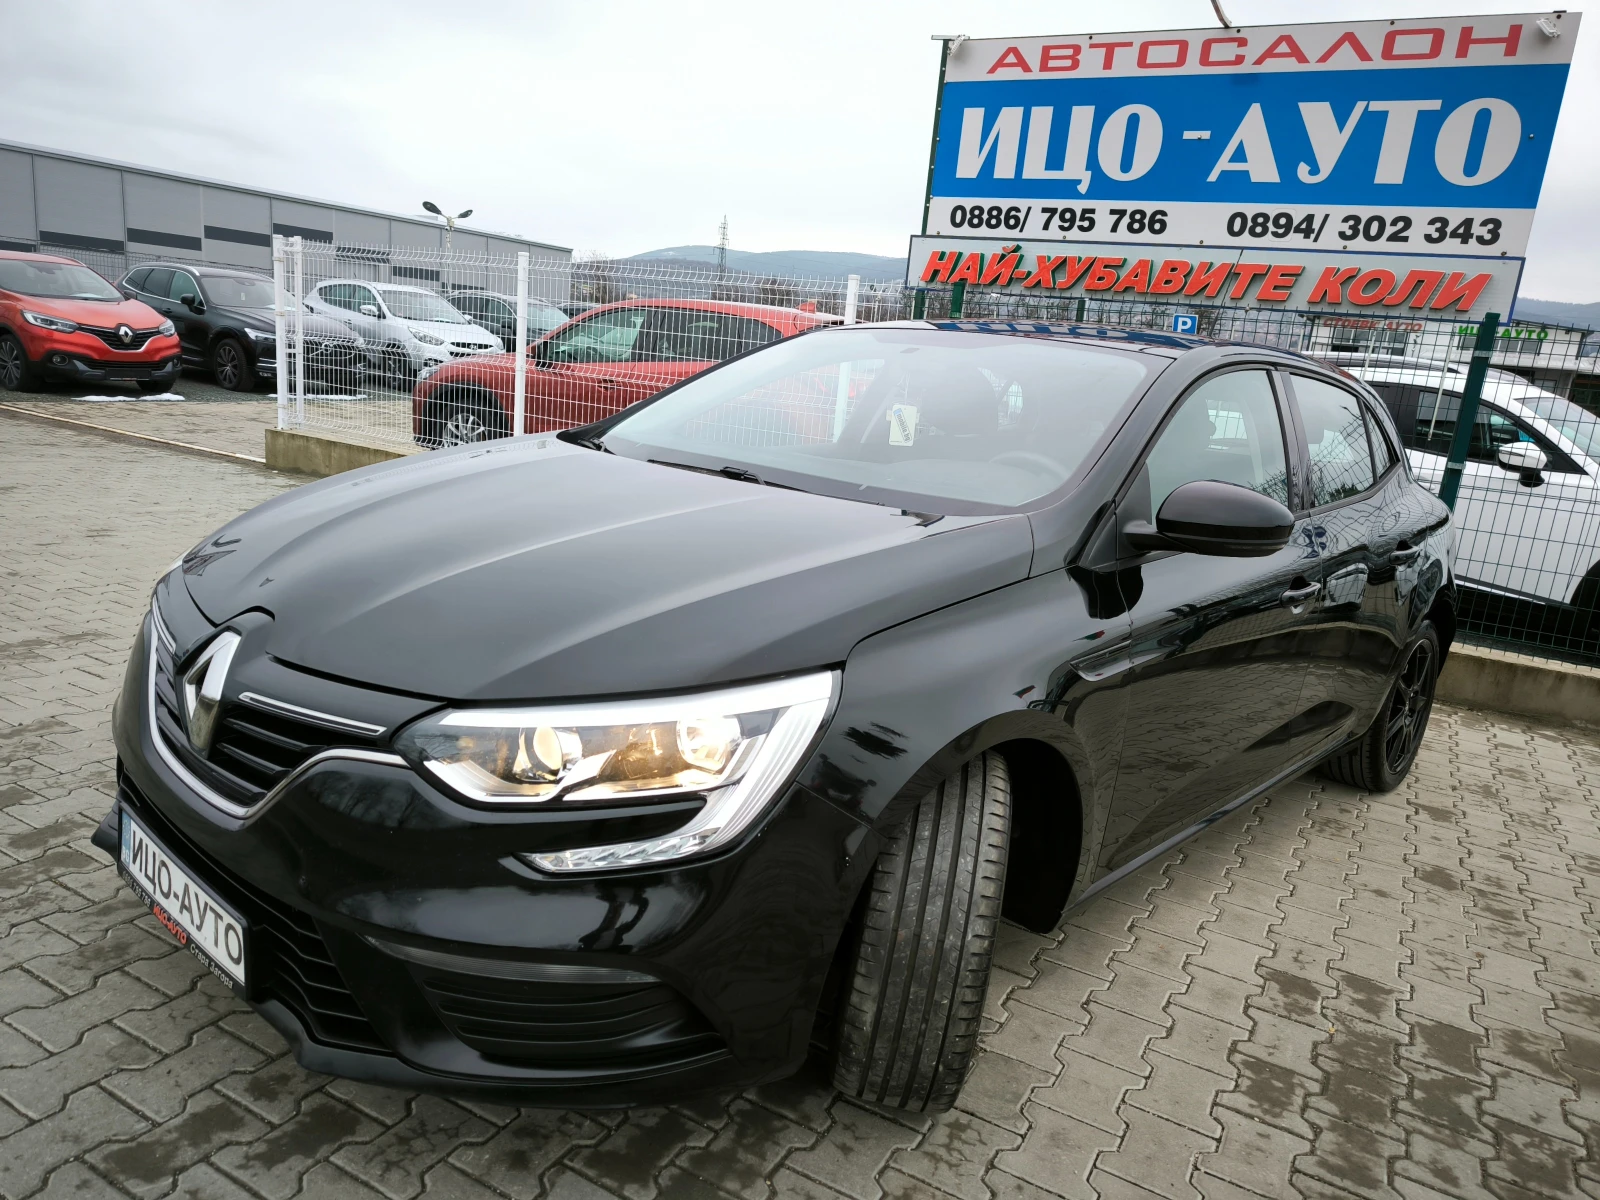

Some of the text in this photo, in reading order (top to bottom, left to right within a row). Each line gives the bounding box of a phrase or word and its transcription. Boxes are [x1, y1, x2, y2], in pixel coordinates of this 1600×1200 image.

[987, 24, 1522, 74] АВТОСАЛОН
[950, 205, 1503, 246] 0886/ 795 786 0894/ 302 343
[920, 244, 1494, 312] НАЙ-ХУБАВИТЕ КОЛИ
[1177, 316, 1192, 333] P
[132, 829, 242, 966] ИЦО-АУТО
[153, 902, 187, 945] ИЦО-АУТО
[190, 943, 209, 967] Стара
[209, 961, 234, 990] Загора
